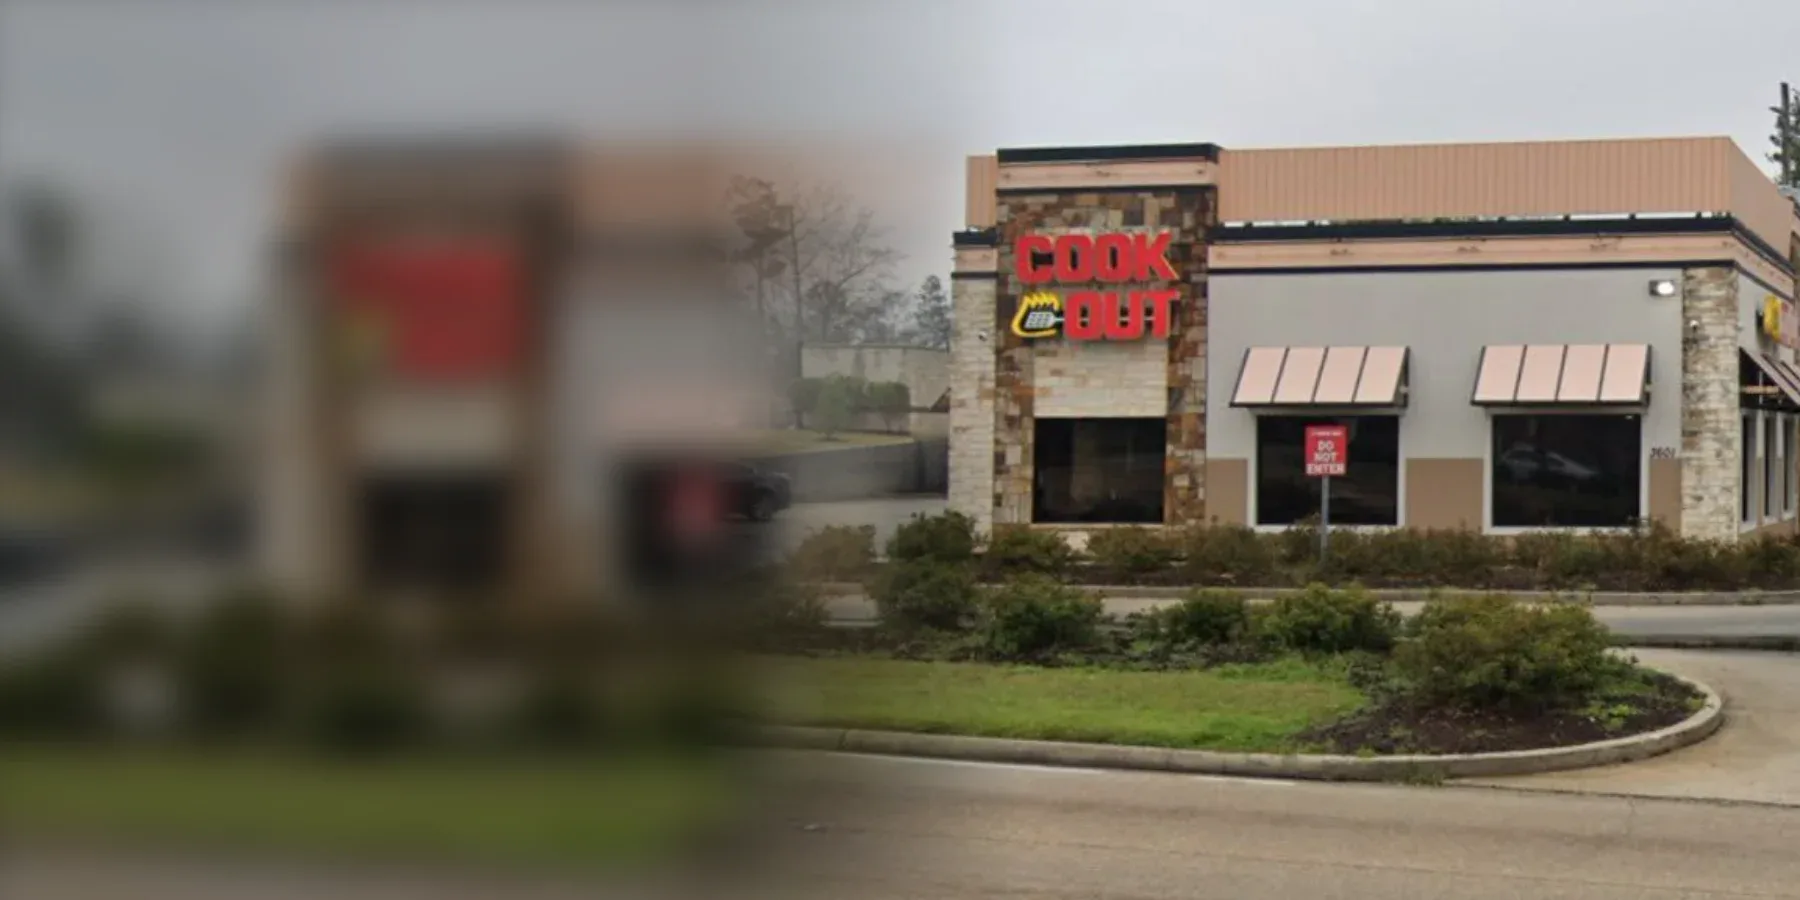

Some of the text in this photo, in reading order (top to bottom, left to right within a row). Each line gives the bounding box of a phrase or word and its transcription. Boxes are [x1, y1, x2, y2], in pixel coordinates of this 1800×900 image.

[1016, 231, 1179, 283] COOK
[1065, 290, 1181, 340] OUT
[1317, 440, 1335, 451] DO
[1314, 451, 1338, 463] NOT
[1306, 463, 1346, 475] ENTER
